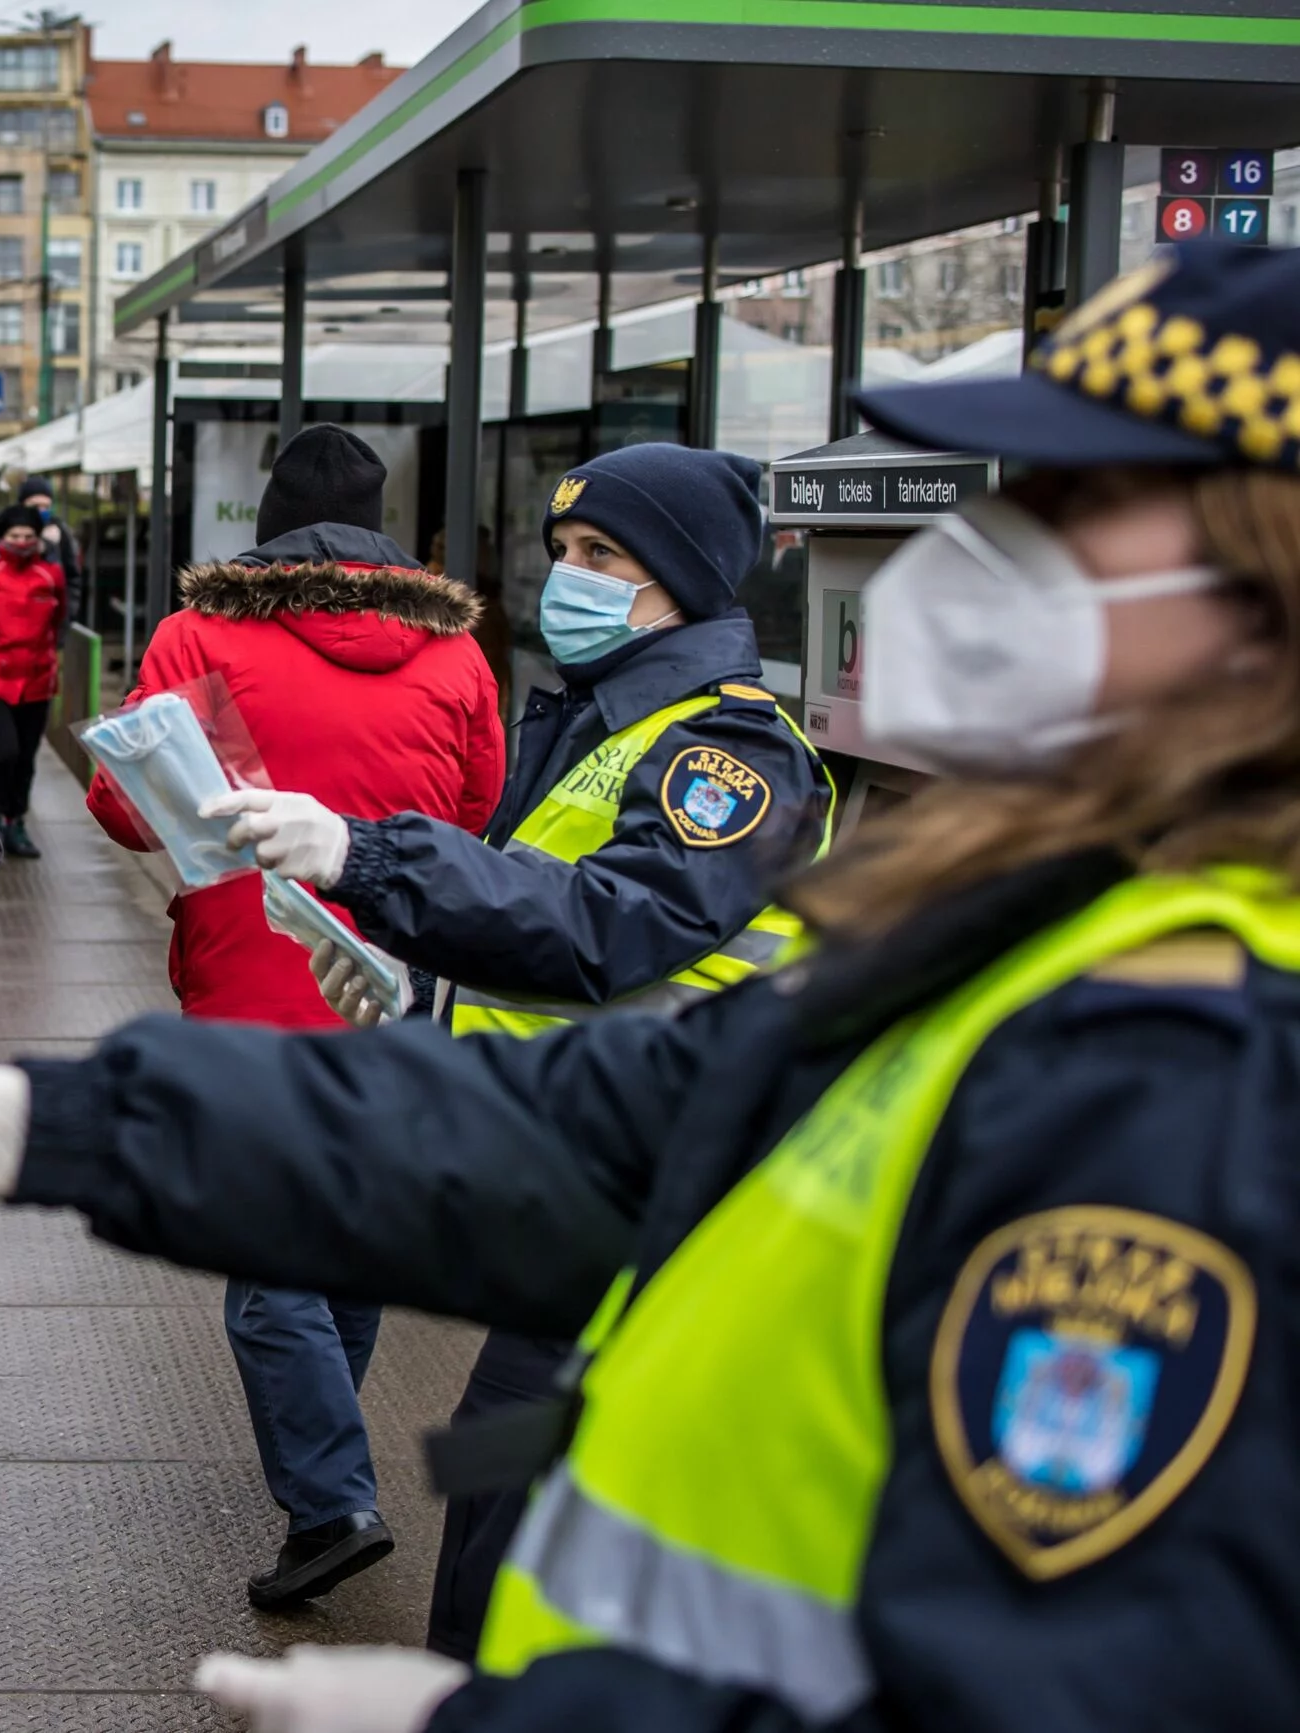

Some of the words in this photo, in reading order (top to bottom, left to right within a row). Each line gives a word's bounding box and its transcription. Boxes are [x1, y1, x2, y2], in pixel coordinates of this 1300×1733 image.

[1180, 160, 1197, 184] 3
[1230, 160, 1261, 184] 16
[1174, 208, 1192, 232] 8
[1225, 209, 1257, 234] 17
[790, 476, 824, 511] bilety
[838, 478, 872, 503] tickets
[898, 477, 957, 503] fahrkarten
[687, 760, 755, 802] MIEJSKA
